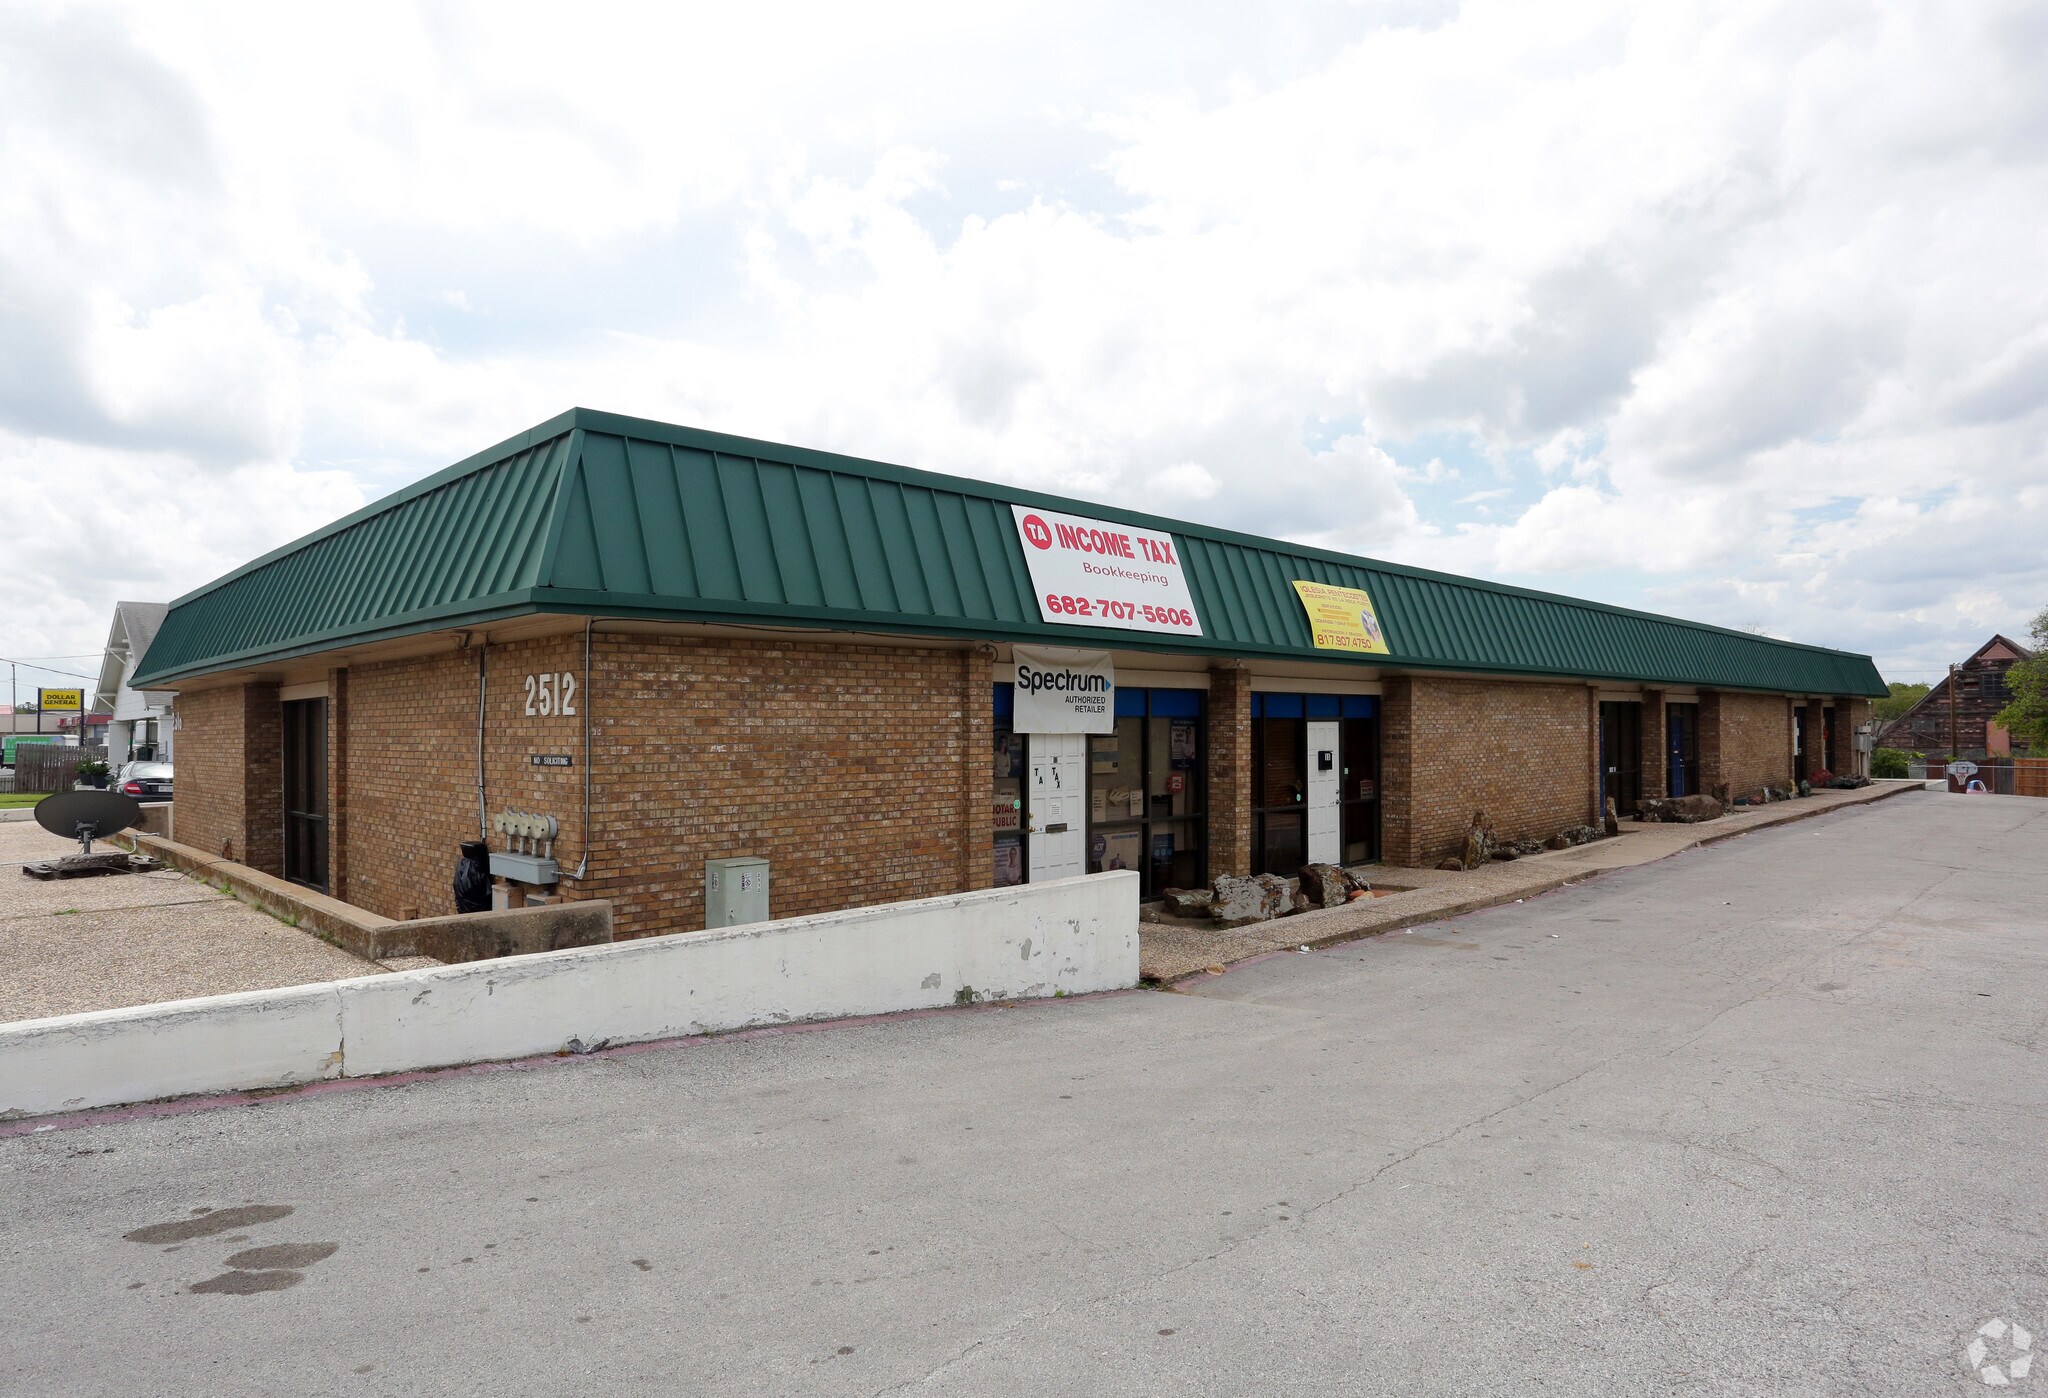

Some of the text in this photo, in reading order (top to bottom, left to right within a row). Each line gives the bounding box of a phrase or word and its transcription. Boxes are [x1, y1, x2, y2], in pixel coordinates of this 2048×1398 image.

[1027, 523, 1048, 542] TA
[1054, 522, 1177, 566] INCOME TAX
[1082, 562, 1169, 587] Bookkeeping
[1046, 593, 1193, 627] 682-707-5606
[1317, 635, 1371, 648] 817.907.4750
[1018, 665, 1105, 695] Spectrum
[525, 672, 576, 716] 2512
[1065, 696, 1106, 704] AUTHORIZED
[1075, 705, 1105, 713] RETAILER
[533, 756, 568, 765] NO SOLICITING
